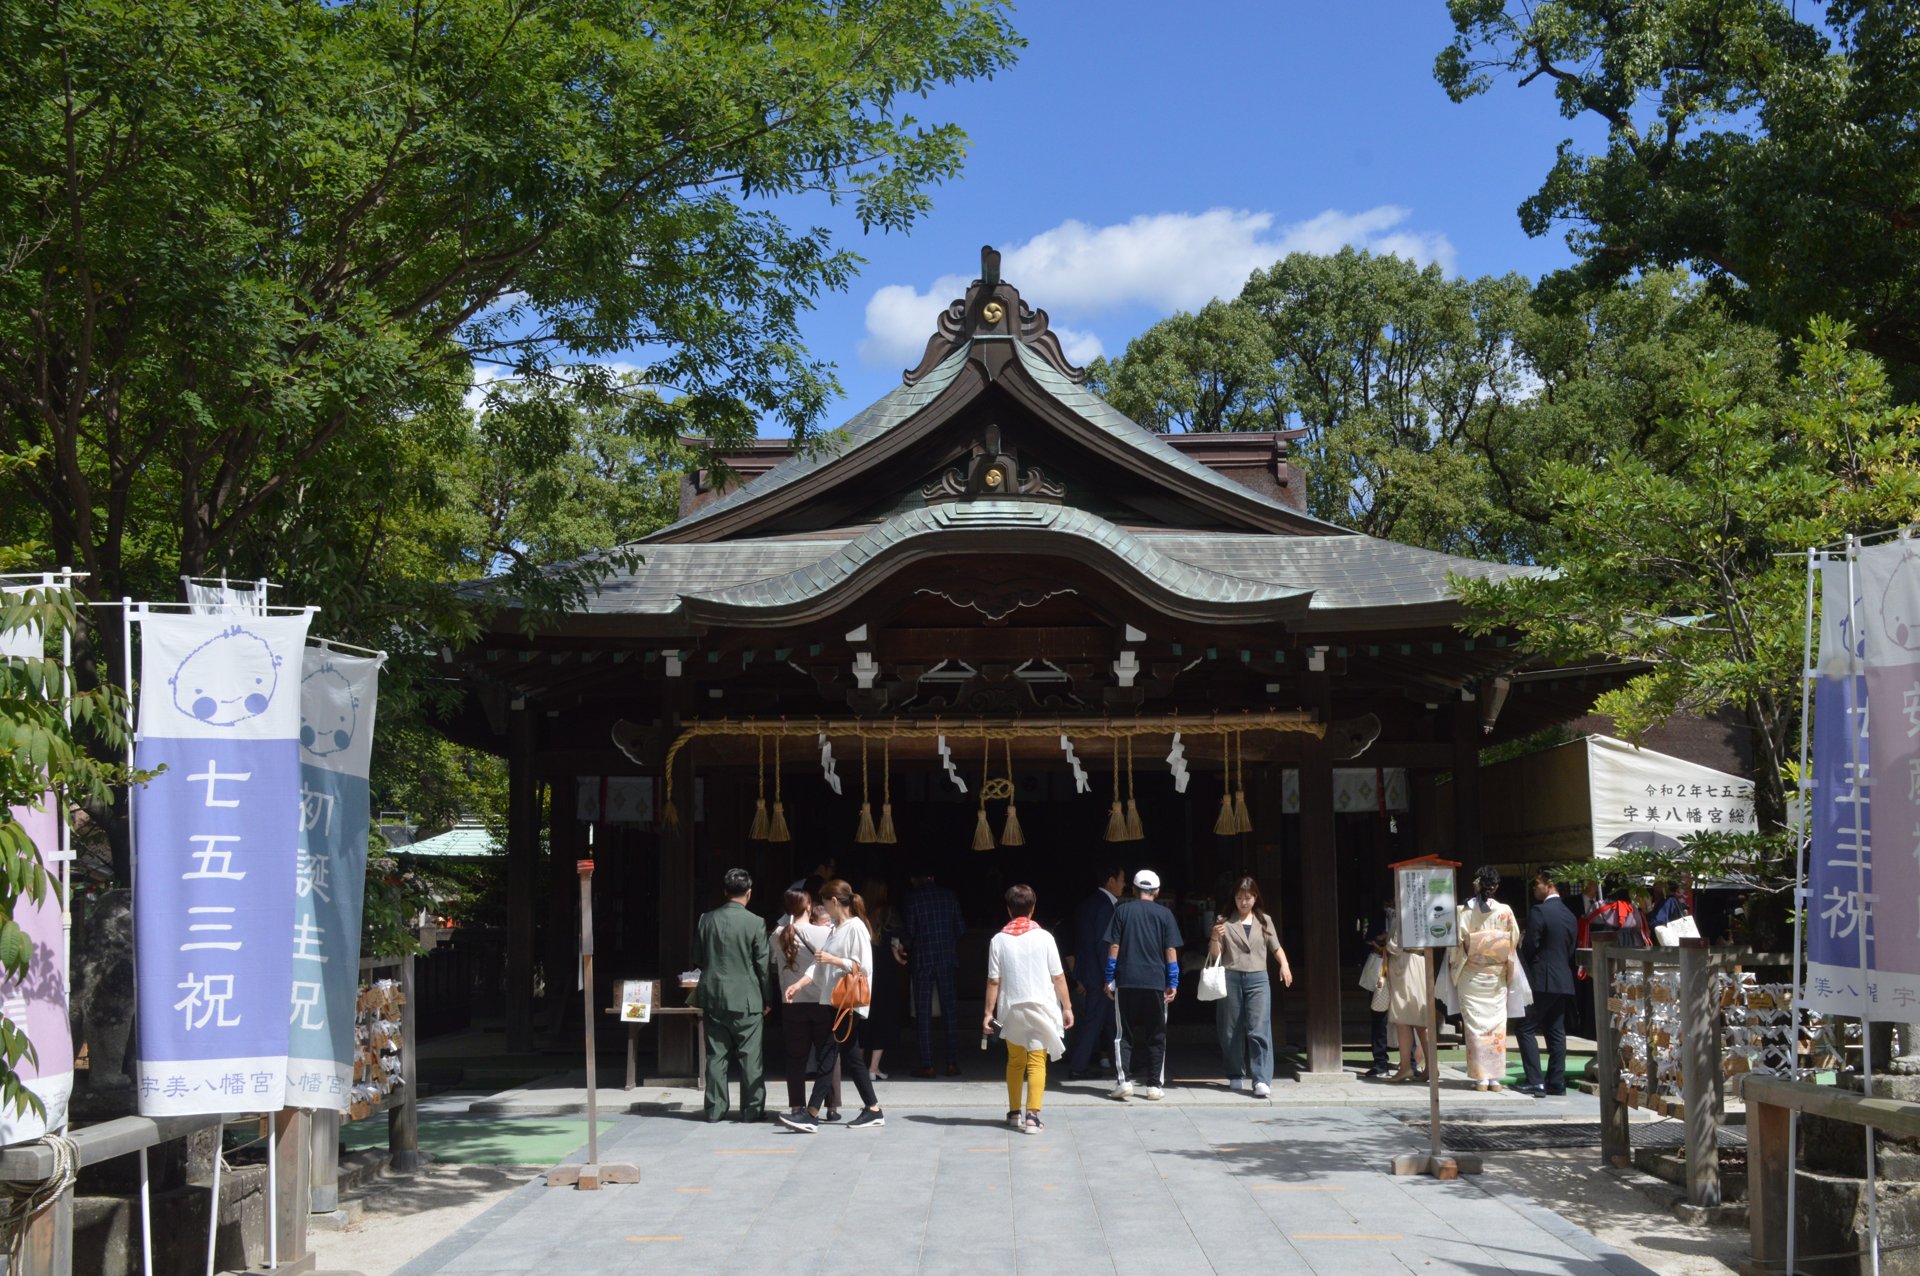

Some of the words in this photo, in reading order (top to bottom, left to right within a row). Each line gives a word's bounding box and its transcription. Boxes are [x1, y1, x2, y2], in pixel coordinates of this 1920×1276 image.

[173, 759, 251, 1031] 七五三祝
[139, 1071, 274, 1098] 宇美八幡宮
